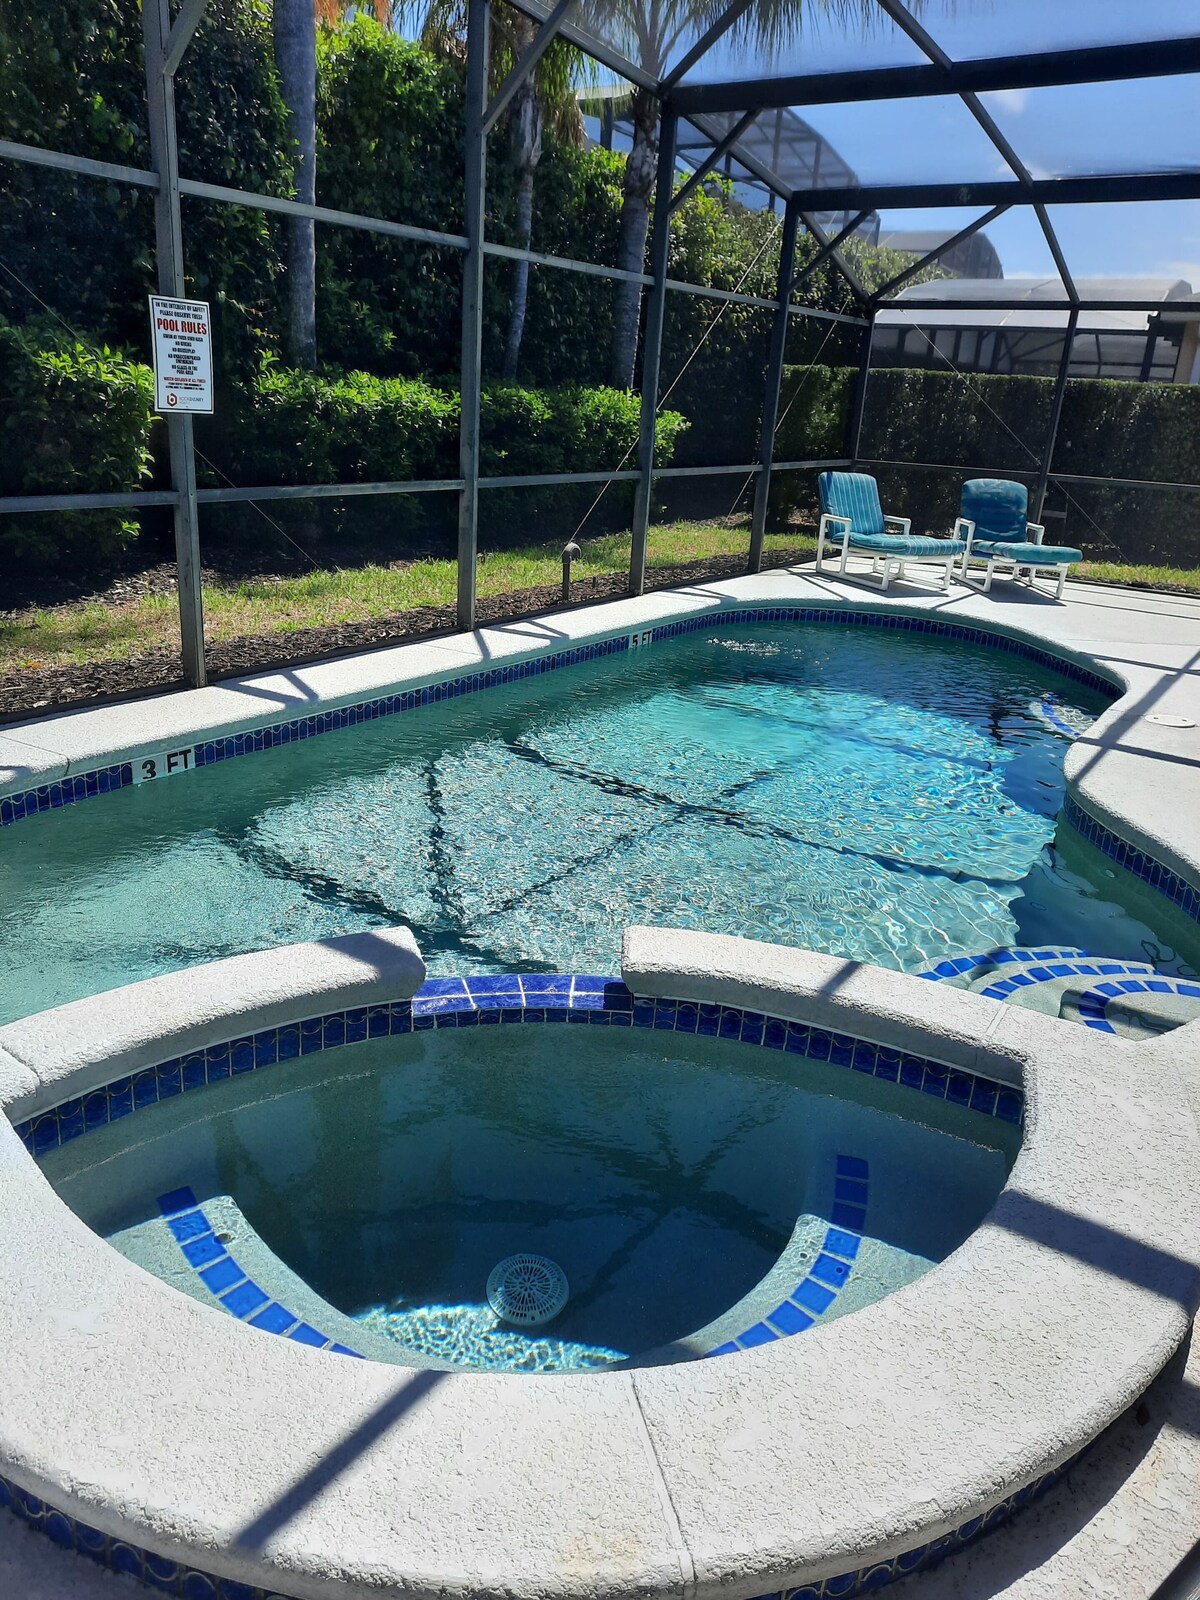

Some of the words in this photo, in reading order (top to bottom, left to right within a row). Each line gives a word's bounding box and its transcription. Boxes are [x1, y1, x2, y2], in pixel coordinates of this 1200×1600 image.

[156, 318, 180, 332] POOL
[181, 320, 207, 335] RULES
[632, 634, 639, 647] 5
[642, 630, 652, 646] FT
[142, 760, 156, 780] 3
[166, 748, 192, 774] FT
